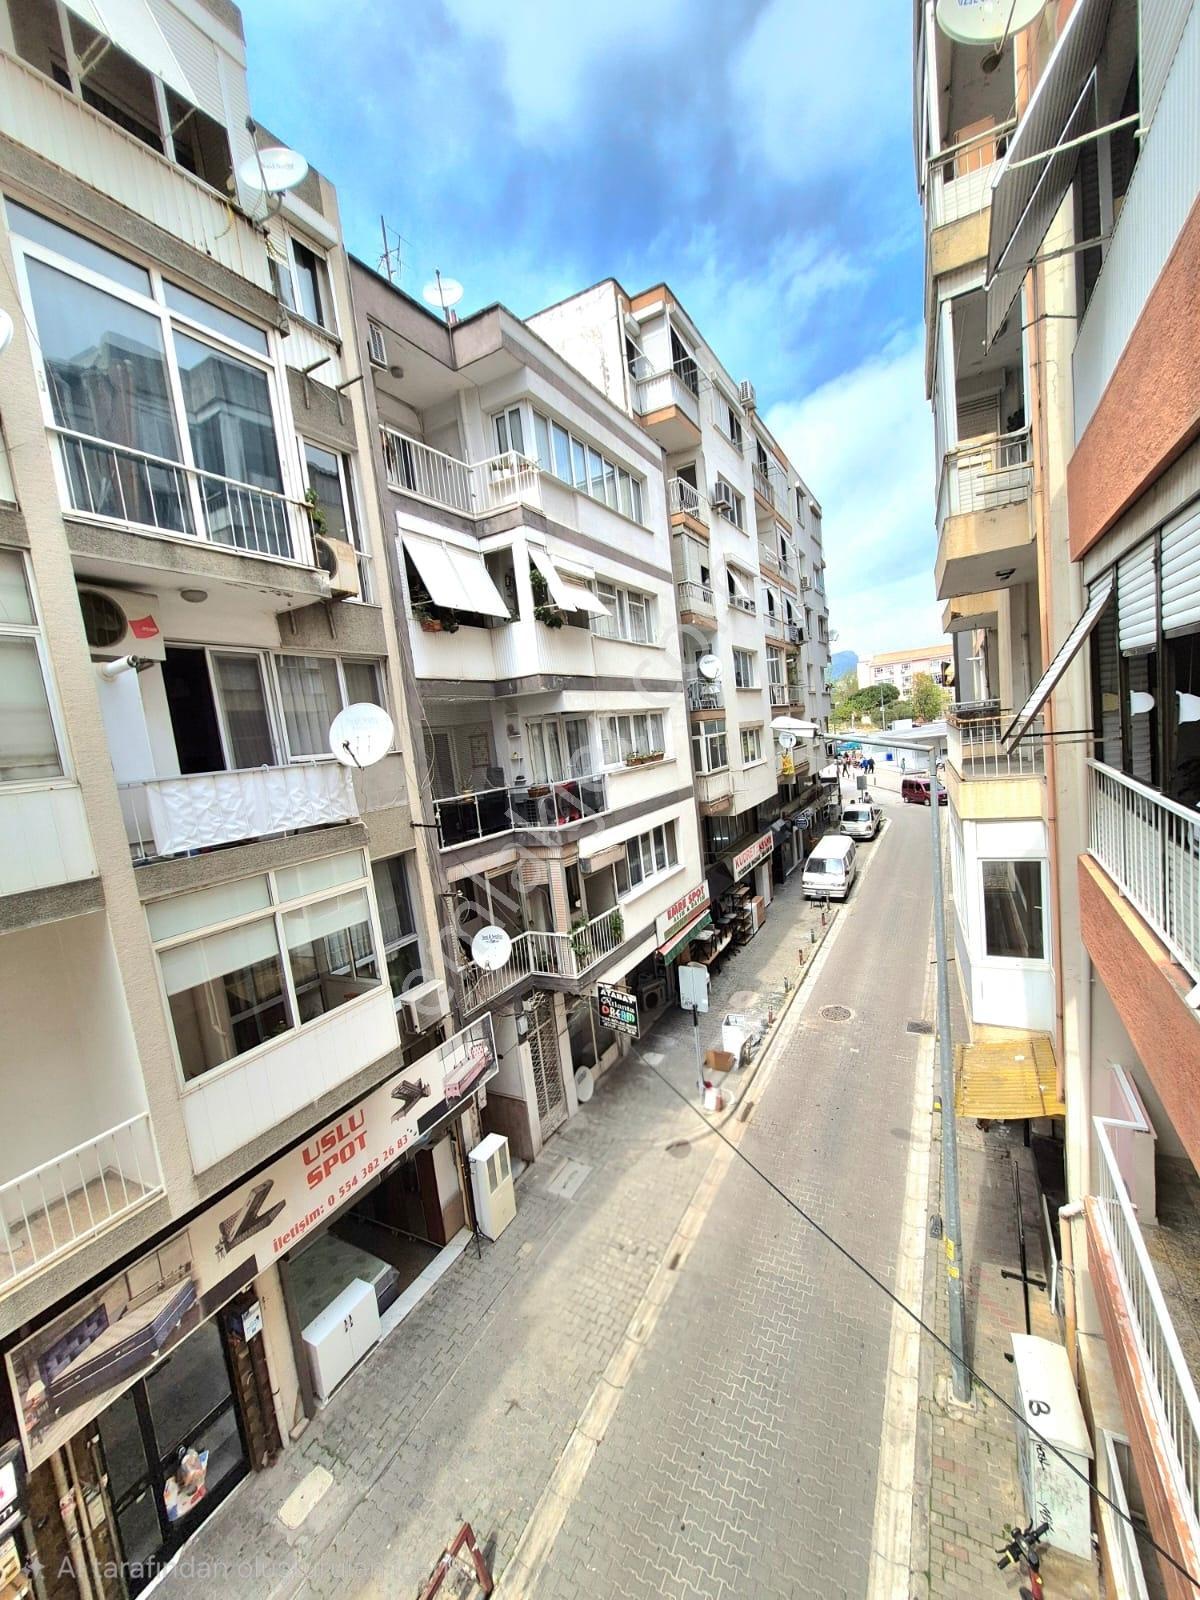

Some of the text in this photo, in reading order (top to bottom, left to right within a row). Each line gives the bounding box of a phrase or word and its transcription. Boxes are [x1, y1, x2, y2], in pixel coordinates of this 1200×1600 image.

[667, 898, 687, 920] EMRE
[688, 885, 704, 904] SPOT
[301, 1109, 365, 1167] USLU
[306, 1130, 367, 1190] SPOT
[327, 1194, 335, 1207] 0
[338, 1175, 359, 1198] 554
[361, 1158, 380, 1181] 382
[382, 1147, 395, 1161] 26
[396, 1134, 409, 1149] 83
